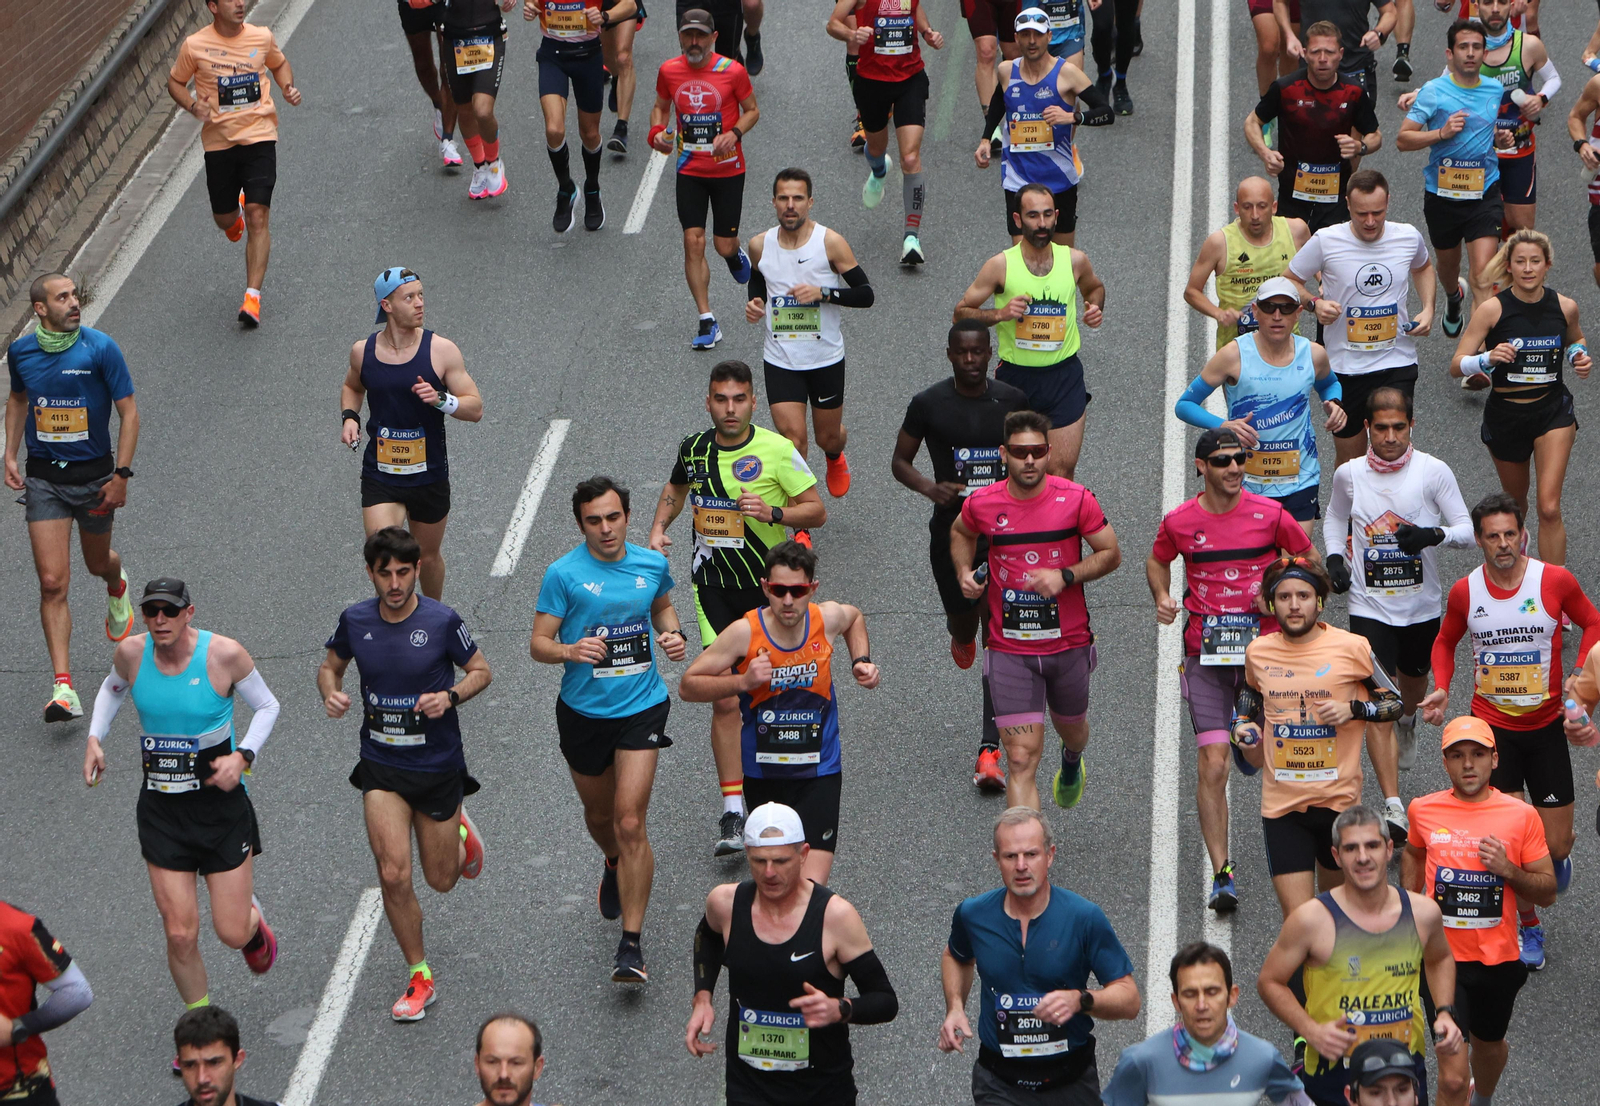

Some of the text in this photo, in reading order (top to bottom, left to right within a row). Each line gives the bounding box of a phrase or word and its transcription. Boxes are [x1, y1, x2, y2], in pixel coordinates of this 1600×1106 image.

[889, 18, 911, 26] ZURICH
[887, 31, 903, 39] 2189
[466, 37, 489, 46] ZURICH
[232, 75, 255, 84] ZURICH
[692, 115, 717, 123] ZURICH
[1023, 113, 1043, 121] ZURIC
[693, 128, 709, 136] 3374
[1022, 126, 1037, 134] 3731
[1453, 173, 1470, 181] 4415
[1309, 178, 1326, 186] 4418
[1230, 276, 1261, 285] AMIGOS
[1034, 306, 1061, 315] ZURICH
[1364, 308, 1392, 316] ZURICH
[788, 313, 804, 321] 1392
[795, 324, 818, 332] GOUVEIA
[1032, 321, 1050, 330] 5780
[1364, 324, 1381, 332] 4320
[1526, 339, 1555, 347] ZURICH
[1526, 354, 1543, 362] 3371
[51, 414, 69, 422] 4113
[1257, 410, 1295, 430] RUNNING
[392, 430, 420, 439] ZURICH
[391, 446, 410, 454] 5579
[1264, 441, 1293, 450] ZURICH
[1262, 457, 1281, 465] 6175
[972, 466, 992, 475] 3200
[706, 515, 725, 524] 4199
[703, 528, 729, 536] EUGENIO
[1382, 551, 1414, 559] ZURIC
[1383, 567, 1403, 576] 2875
[1384, 579, 1415, 587] MARAVER
[1019, 609, 1039, 619] 2475
[1221, 615, 1251, 625] ZURICH
[613, 624, 643, 635] ZURICH
[1019, 622, 1042, 630] SERRA
[1220, 632, 1240, 641] 2619
[1472, 626, 1544, 641] CLUB TRIATLÓN
[1482, 635, 1534, 647] ALGECIRAS
[613, 643, 631, 653] 3441
[1216, 646, 1245, 654] GUILLEM
[612, 657, 635, 666] DANIEL
[1500, 656, 1533, 665] ZURICH
[772, 659, 818, 679] TRIATLÓ
[770, 673, 818, 692] PRAT
[1499, 673, 1520, 683] 5387
[1269, 690, 1300, 698] Maratón
[382, 697, 415, 706] ZURICH
[383, 713, 402, 723] 3057
[779, 712, 814, 721] ZURICH
[383, 727, 405, 735] CURRO
[1004, 724, 1034, 736] XXVI
[1293, 727, 1327, 737] ZURICH
[778, 731, 800, 740] 3488
[158, 740, 192, 749] ZURICH
[1293, 747, 1314, 756] 5523
[158, 759, 178, 768] 3250
[1286, 761, 1305, 769] DAVID
[171, 773, 196, 781] LIZANA
[1458, 873, 1496, 883] ZURICH
[1456, 893, 1480, 904] 3462
[1457, 908, 1478, 917] DANO
[1017, 997, 1041, 1007] ZUR
[761, 1014, 800, 1025] ZURICH
[1371, 1010, 1407, 1023] ZURICH
[1017, 1018, 1042, 1029] 2670
[761, 1033, 785, 1044] 1370
[1013, 1034, 1049, 1045] RICHARD
[750, 1048, 796, 1059] JEAN-MARC
